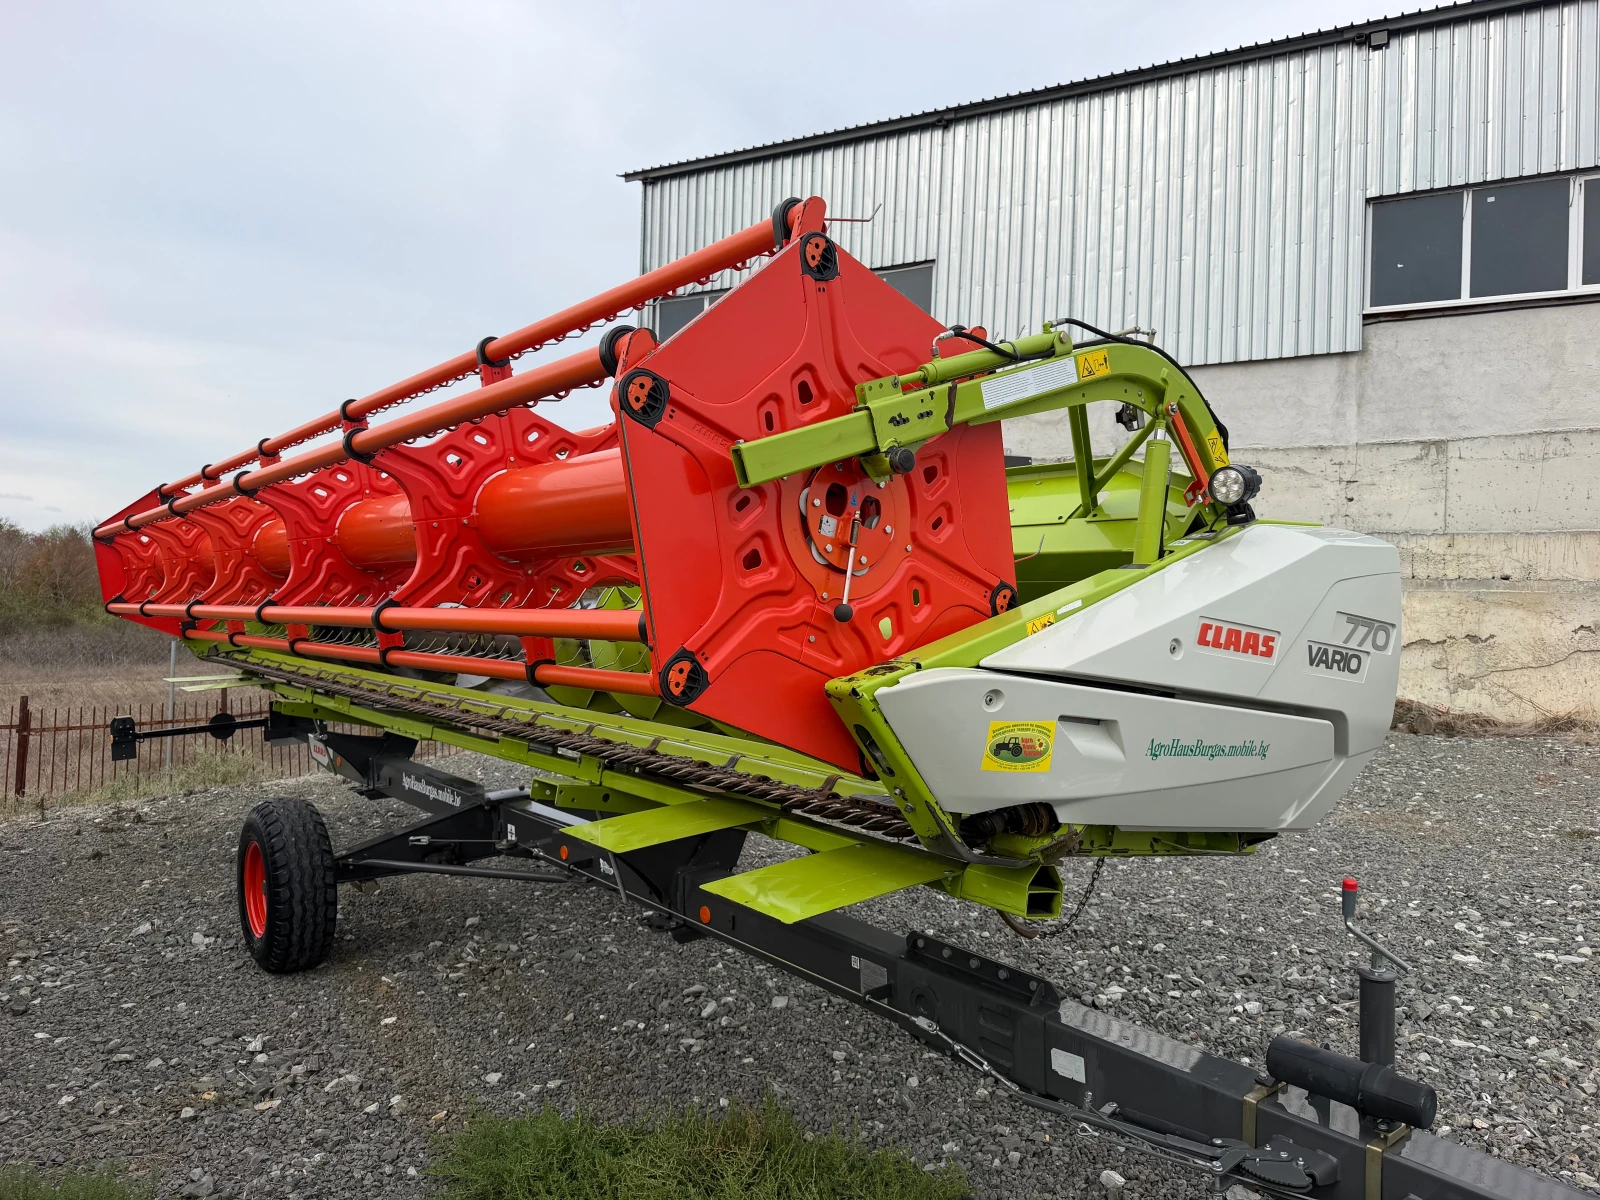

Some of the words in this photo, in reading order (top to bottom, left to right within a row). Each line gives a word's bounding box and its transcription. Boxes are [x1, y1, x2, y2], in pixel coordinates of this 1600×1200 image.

[1197, 622, 1276, 658] CLAAS
[1342, 616, 1391, 652] 770
[1307, 644, 1362, 674] VARIO
[1145, 737, 1270, 761] AgroHausBurgas.mobile.bg
